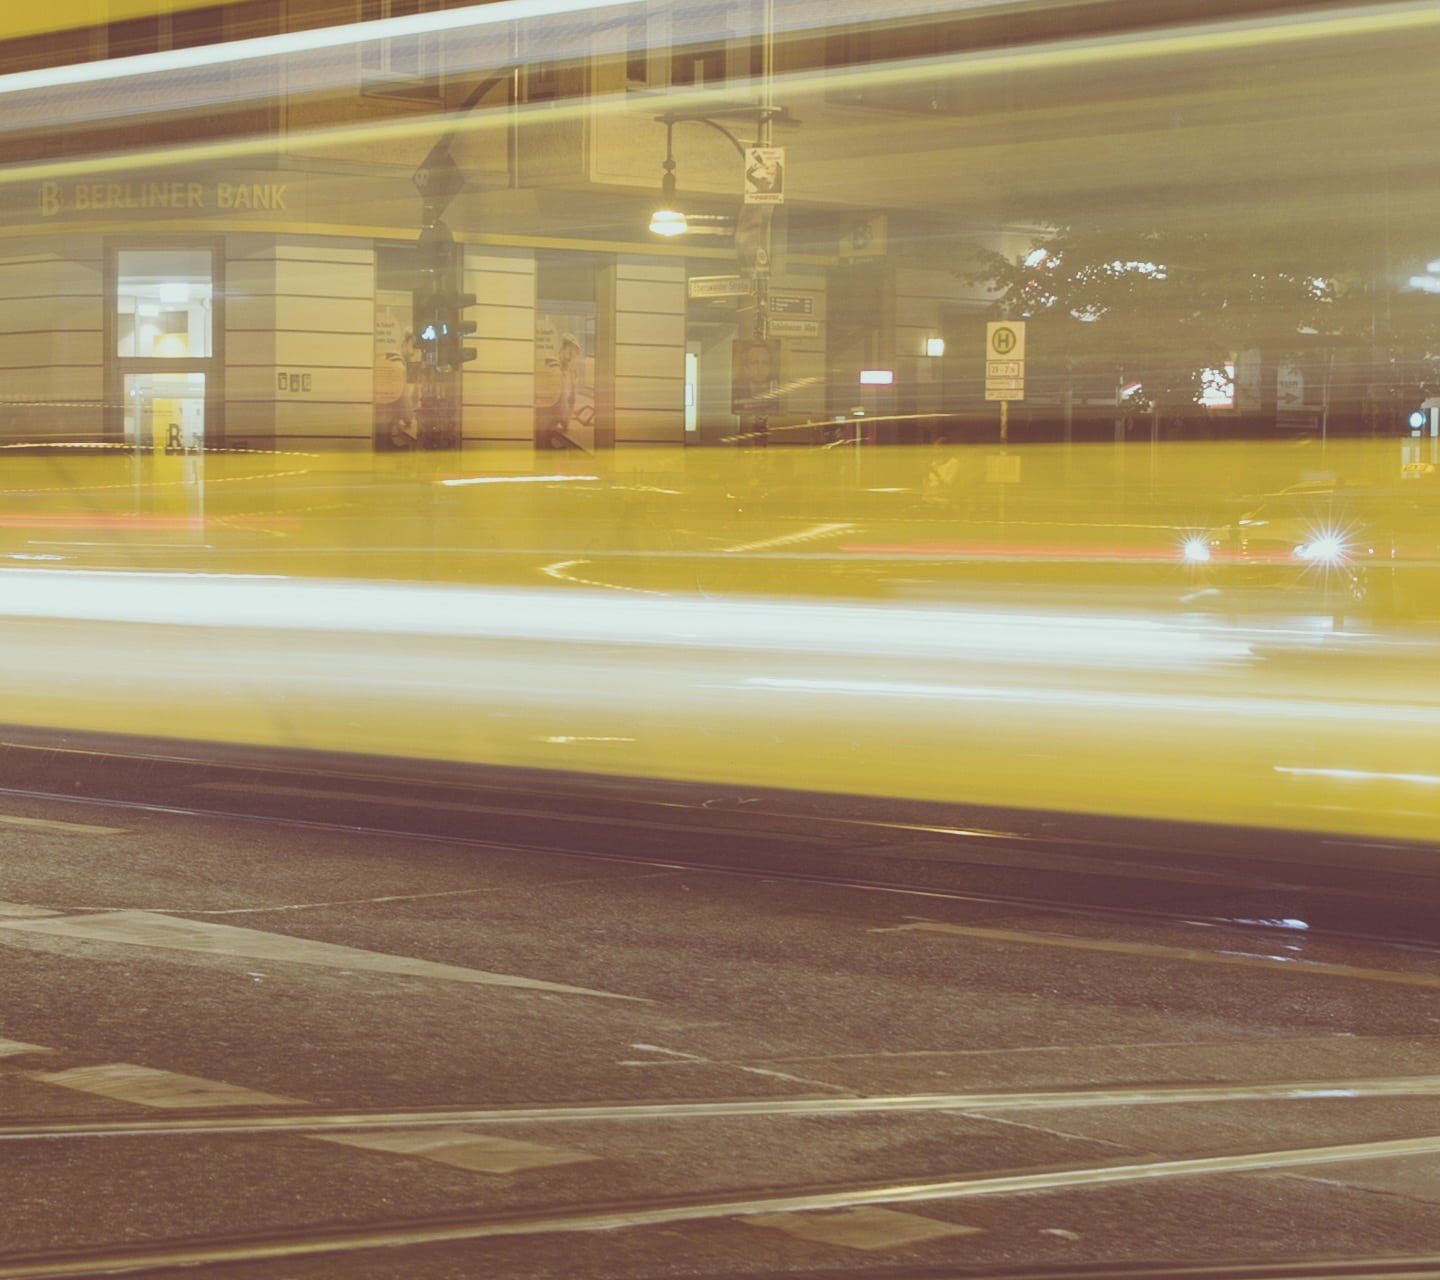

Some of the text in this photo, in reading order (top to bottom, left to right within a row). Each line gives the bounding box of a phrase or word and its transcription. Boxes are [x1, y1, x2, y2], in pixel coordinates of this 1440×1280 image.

[76, 183, 203, 209] BERLINER
[217, 183, 287, 209] BANK
[997, 333, 1010, 349] H
